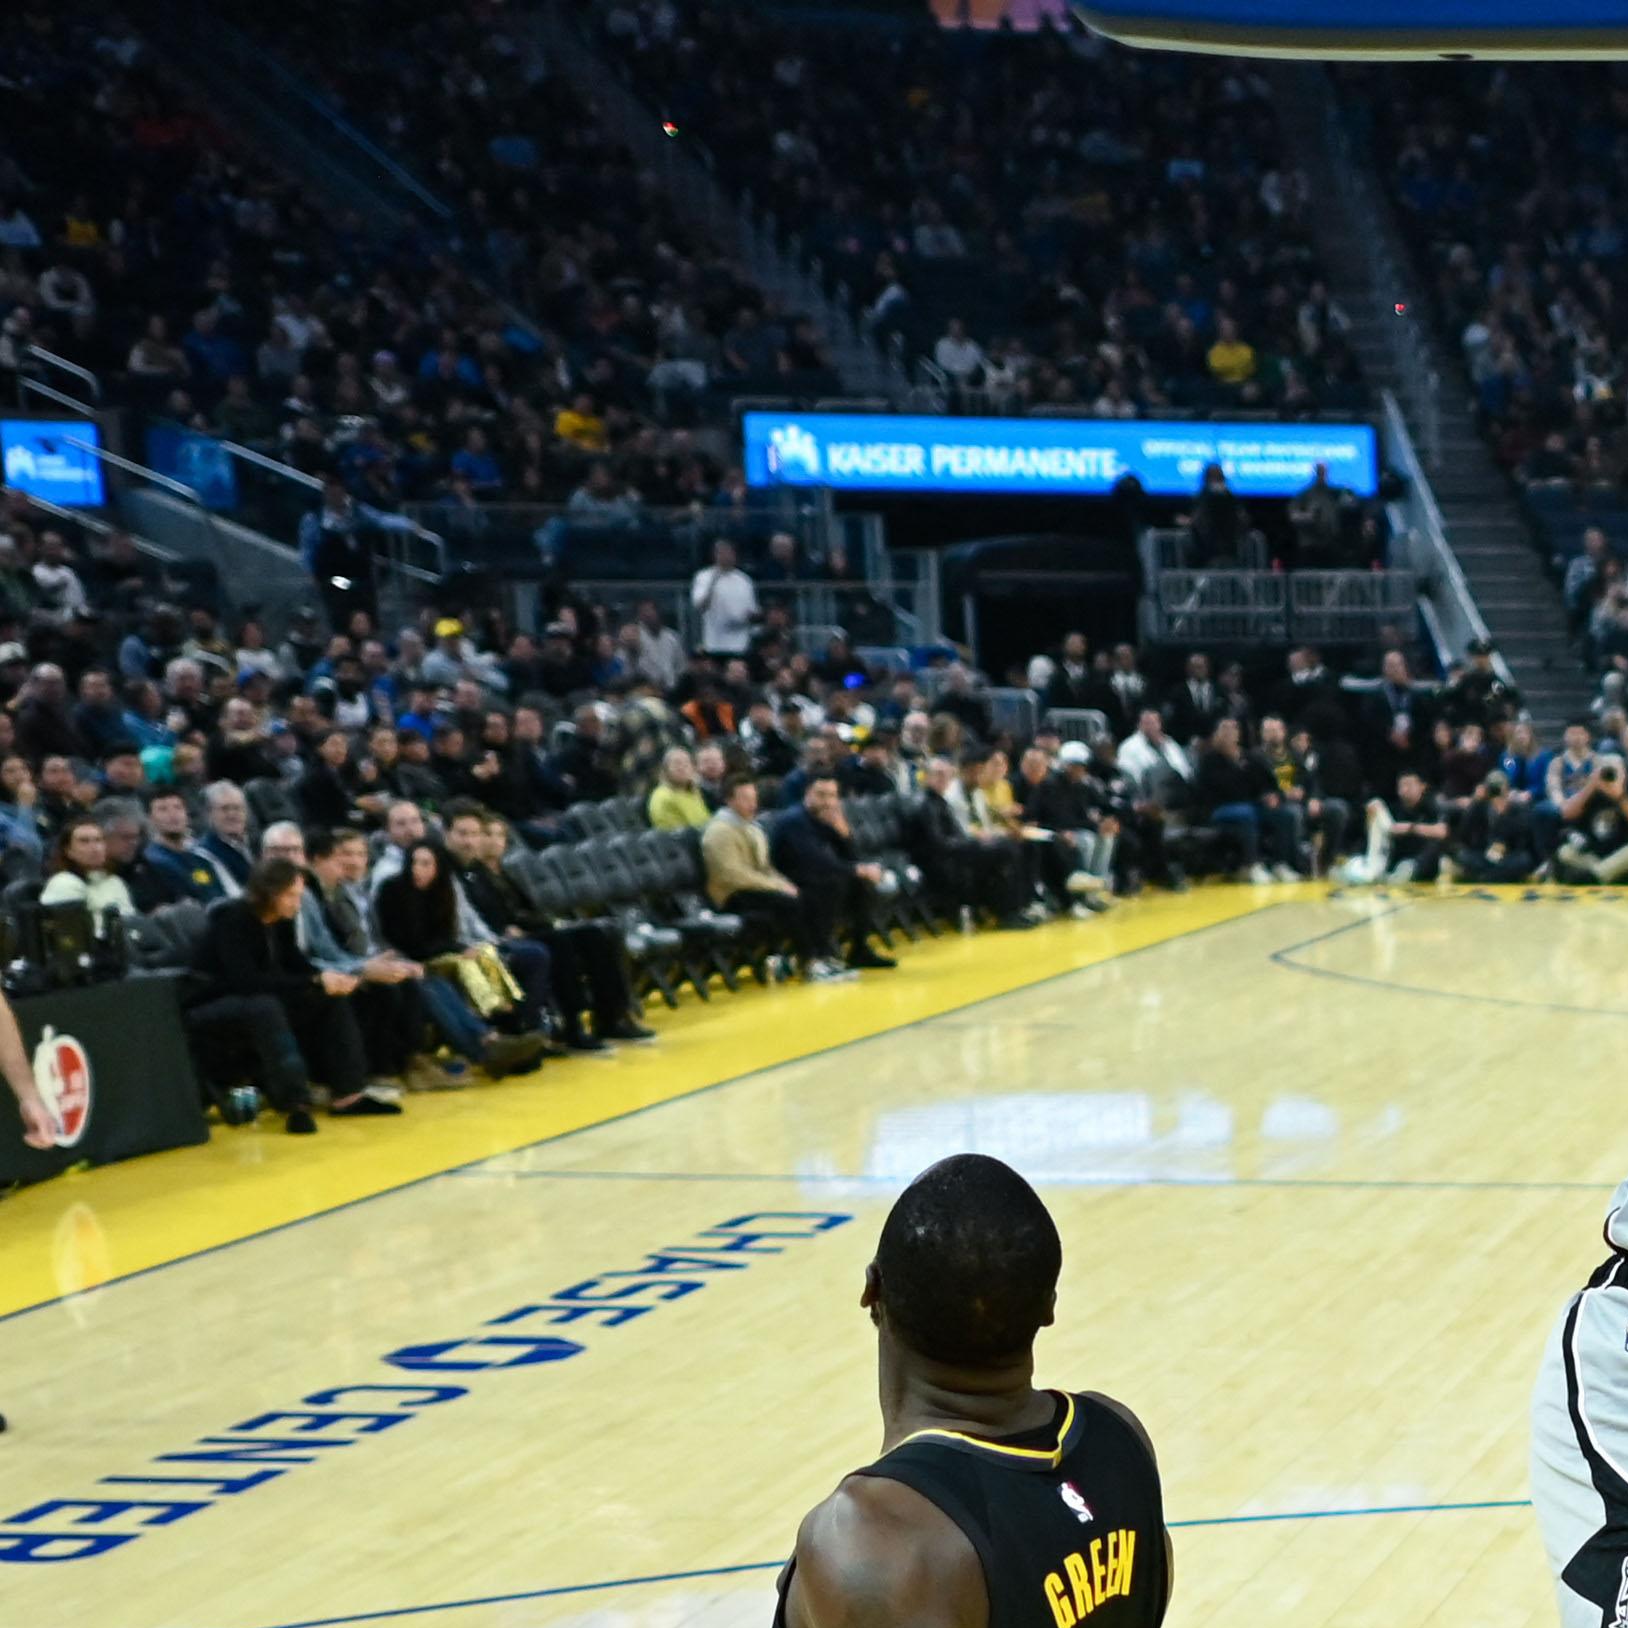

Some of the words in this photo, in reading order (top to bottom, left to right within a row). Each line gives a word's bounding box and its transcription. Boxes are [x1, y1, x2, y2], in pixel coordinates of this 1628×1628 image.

[829, 444, 926, 475] KAISER
[932, 444, 1119, 478] PERMANENTE
[485, 1210, 854, 1328] CHASE
[0, 1383, 470, 1564] CENTER
